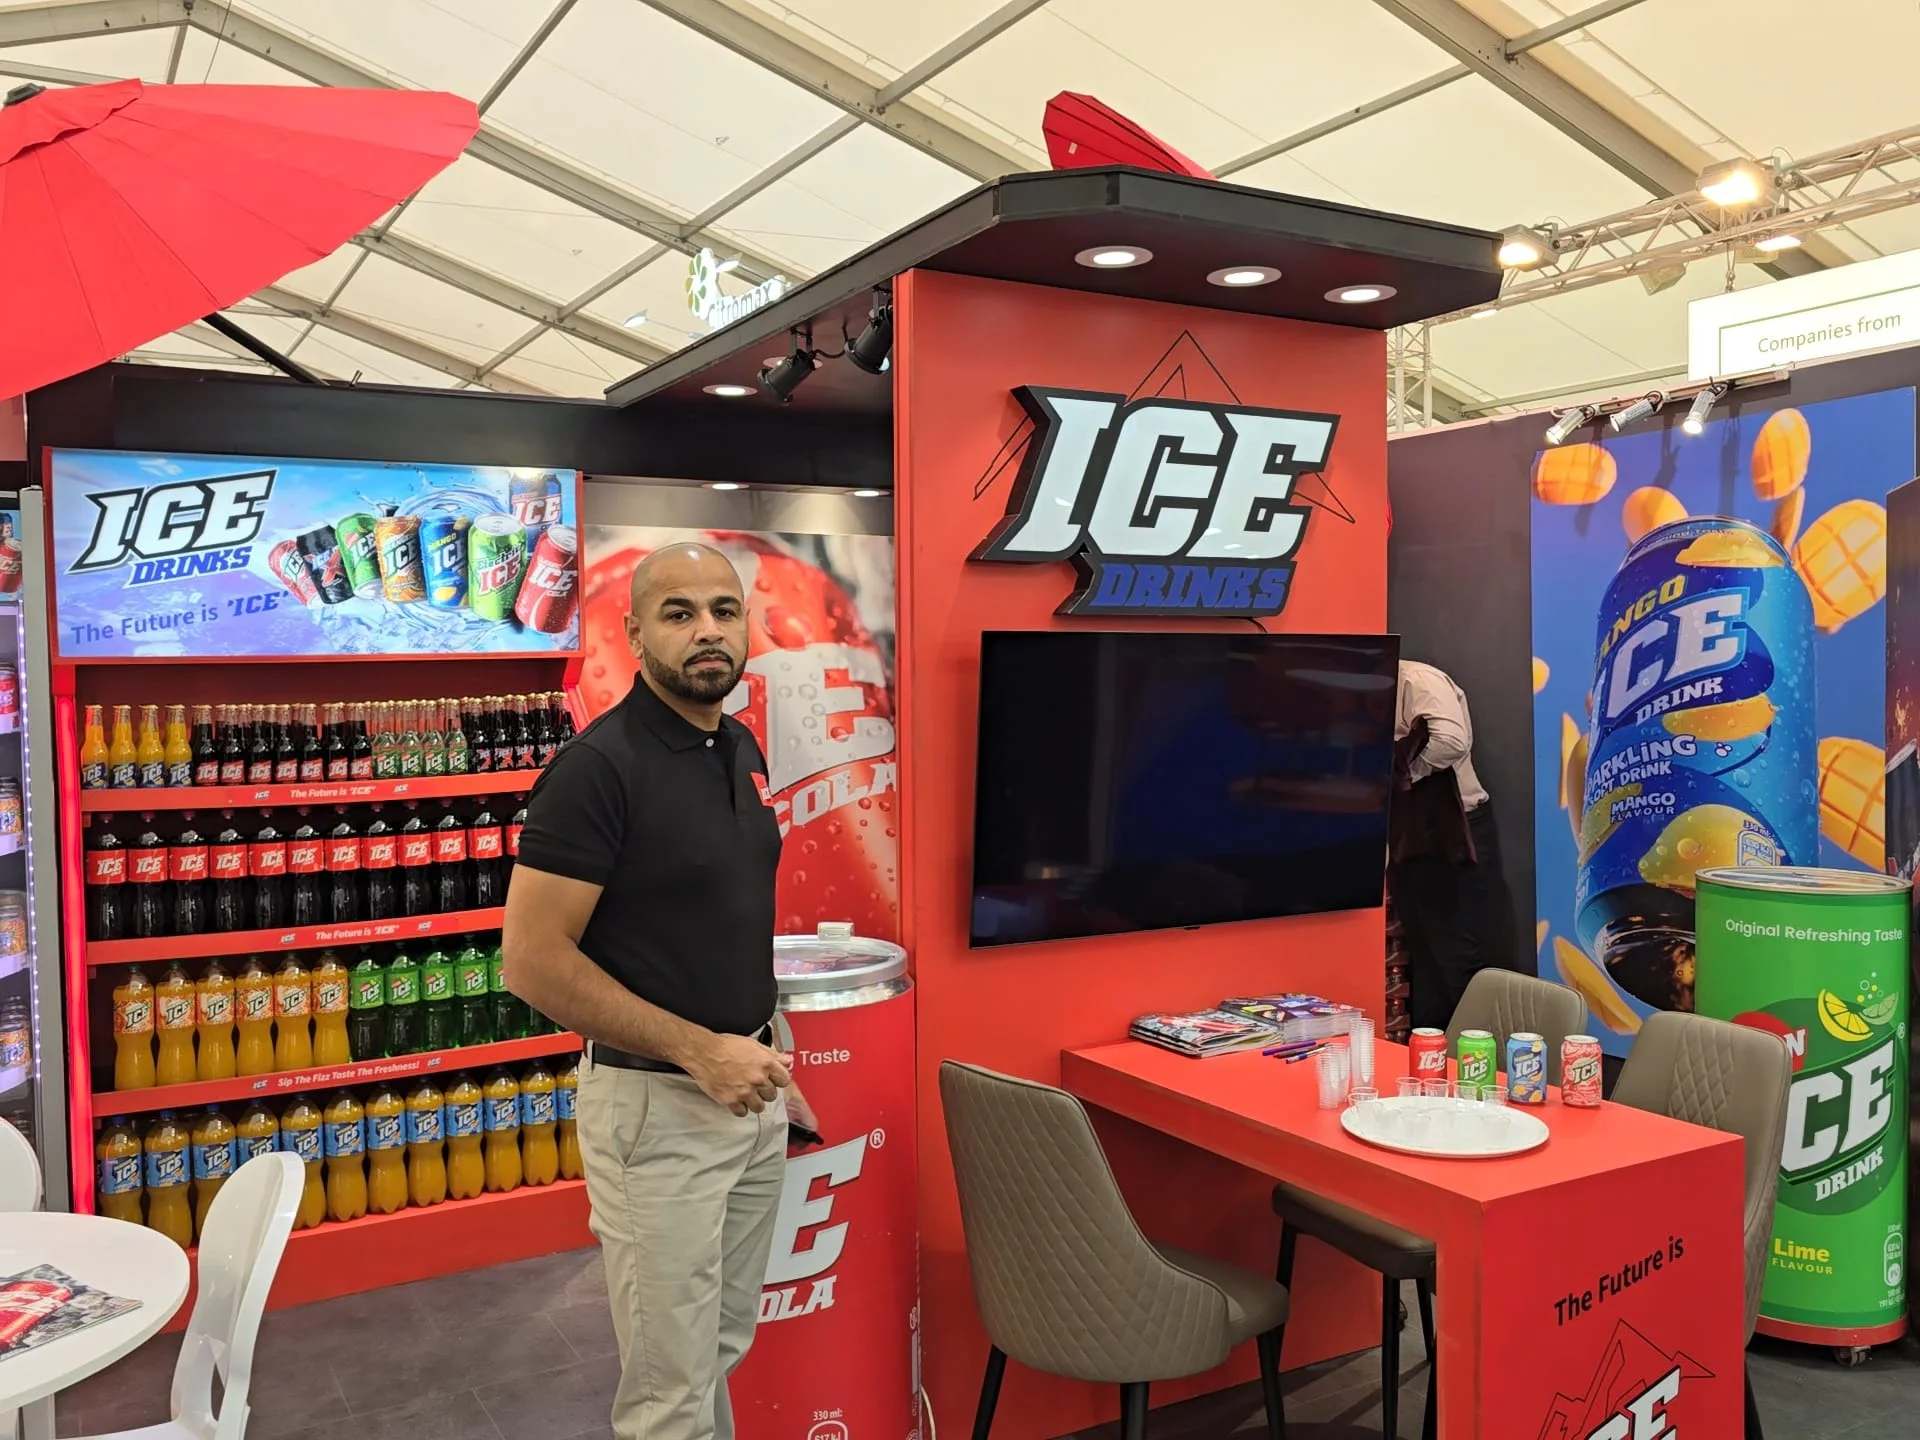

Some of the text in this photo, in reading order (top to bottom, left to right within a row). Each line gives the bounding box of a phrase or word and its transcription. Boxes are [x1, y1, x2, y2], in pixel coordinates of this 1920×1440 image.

[1758, 314, 1901, 353] Companies from
[1003, 396, 1334, 559] ICE
[68, 470, 277, 572] ICE
[129, 546, 252, 585] DRINKS
[479, 554, 520, 596] ICE
[528, 562, 577, 591] ICE
[1089, 562, 1291, 609] DRINKS
[71, 623, 114, 644] The
[122, 609, 194, 636] Future
[202, 604, 218, 622] is
[1635, 676, 1723, 726] DRINK
[291, 789, 307, 798] The
[309, 788, 337, 797] Future
[339, 786, 347, 796] is
[1611, 807, 1674, 823] FLAVOUR
[1612, 793, 1676, 815] MANGO
[370, 844, 395, 860] ICE
[405, 840, 428, 858] ICE
[440, 837, 462, 855] ICE
[477, 833, 500, 851] ICE
[136, 855, 164, 874] ICE
[180, 854, 208, 871] ICE
[216, 851, 243, 870] ICE
[261, 849, 285, 868] ICE
[292, 848, 318, 864] ICE
[333, 845, 358, 862] ICE
[97, 857, 125, 875] ICE
[316, 931, 332, 940] The
[334, 929, 362, 939] Future
[364, 927, 371, 936] is
[1726, 919, 1903, 945] Original Refreshing Taste
[393, 980, 411, 1000] ICE
[427, 976, 446, 995] ICE
[466, 971, 484, 990] ICE
[248, 992, 269, 1016] ICE
[284, 989, 305, 1012] ICE
[320, 985, 341, 1008] ICE
[361, 983, 380, 1004] ICE
[126, 1005, 148, 1029] ICE
[166, 1000, 188, 1025] ICE
[207, 997, 230, 1021] ICE
[799, 1048, 851, 1066] Taste
[1418, 1049, 1447, 1071] ICE
[1515, 1056, 1540, 1078] ICE
[278, 1077, 293, 1088] Sip
[295, 1075, 311, 1085] The
[313, 1073, 331, 1083] Fizz
[356, 1067, 373, 1077] The
[375, 1061, 420, 1074] Freshness!
[1464, 1059, 1488, 1080] ICE
[1573, 1061, 1598, 1083] ICE
[496, 1101, 514, 1122] ICE
[534, 1096, 552, 1117] ICE
[1780, 1039, 1894, 1173] CE
[379, 1118, 399, 1140] ICE
[418, 1113, 437, 1134] ICE
[458, 1107, 477, 1129] ICE
[298, 1133, 318, 1155] ICE
[338, 1125, 358, 1148] ICE
[160, 1154, 182, 1178] ICE
[207, 1148, 230, 1170] ICE
[116, 1160, 138, 1184] ICE
[1814, 1146, 1884, 1201] DRINK
[1774, 1238, 1830, 1263] Lime
[1772, 1258, 1833, 1275] FLAVOUR
[1554, 1235, 1684, 1326] The Future is
[756, 1275, 837, 1323] OLA
[813, 1410, 829, 1421] 330
